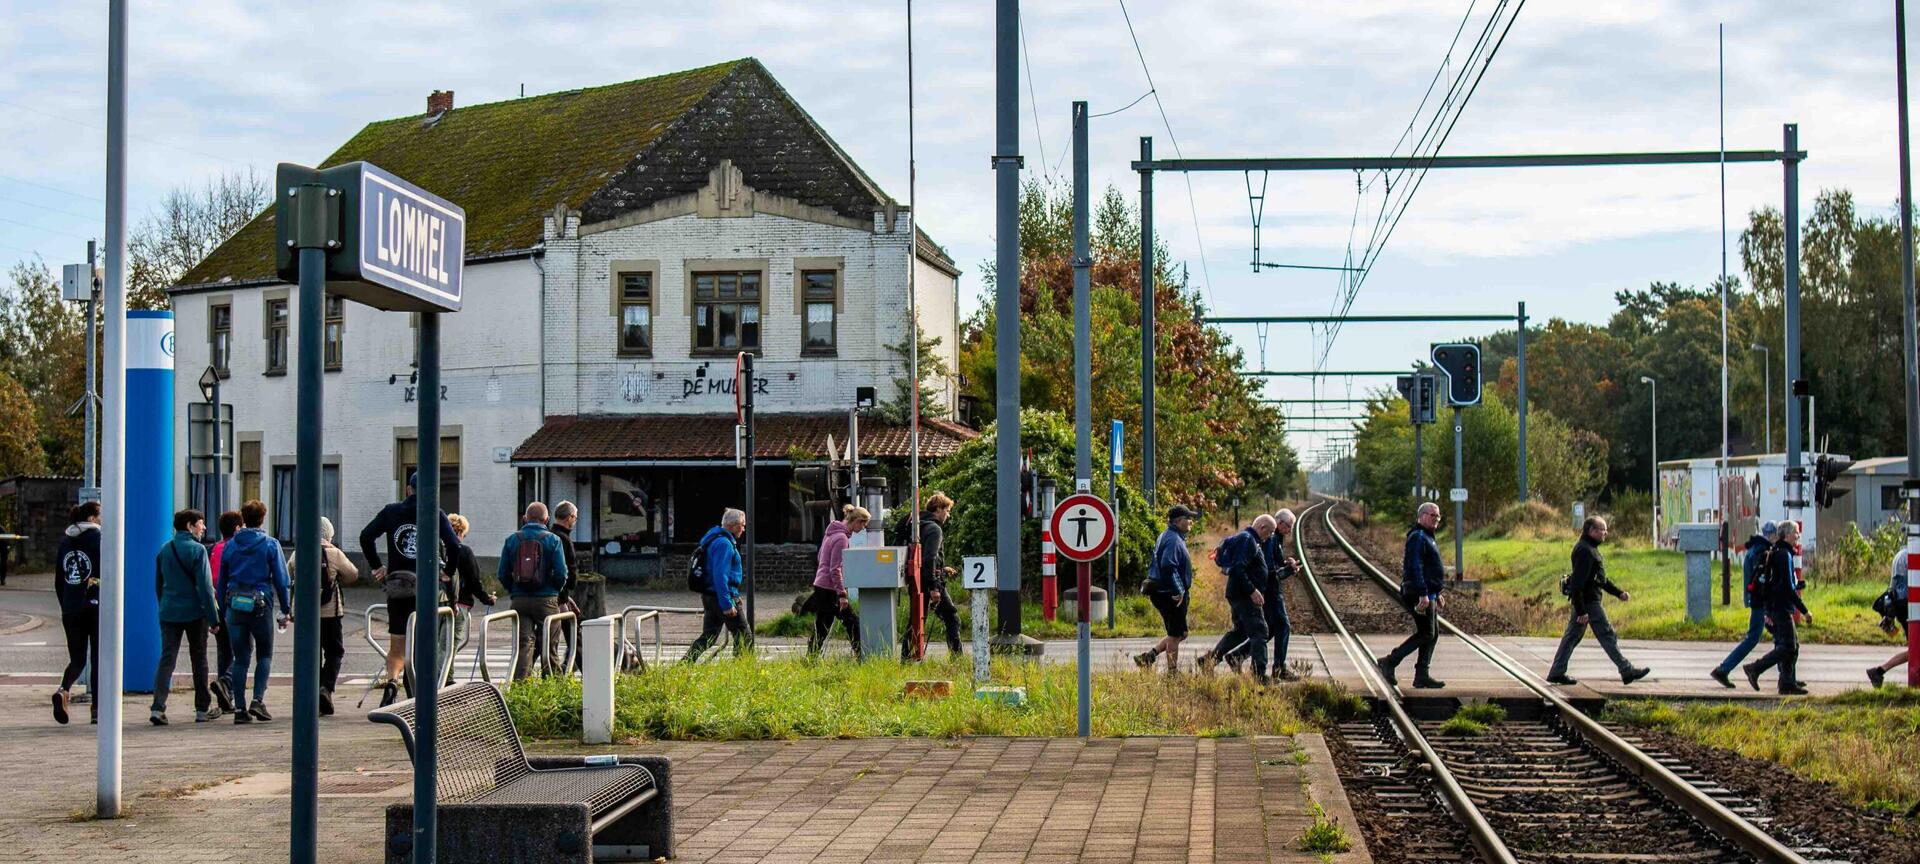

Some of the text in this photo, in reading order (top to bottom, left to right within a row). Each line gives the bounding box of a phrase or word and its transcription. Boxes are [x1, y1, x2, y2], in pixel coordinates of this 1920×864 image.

[377, 191, 449, 285] LOMMEL
[404, 386, 416, 402] DE
[683, 378, 769, 399] DE MULER
[973, 562, 986, 583] 2
